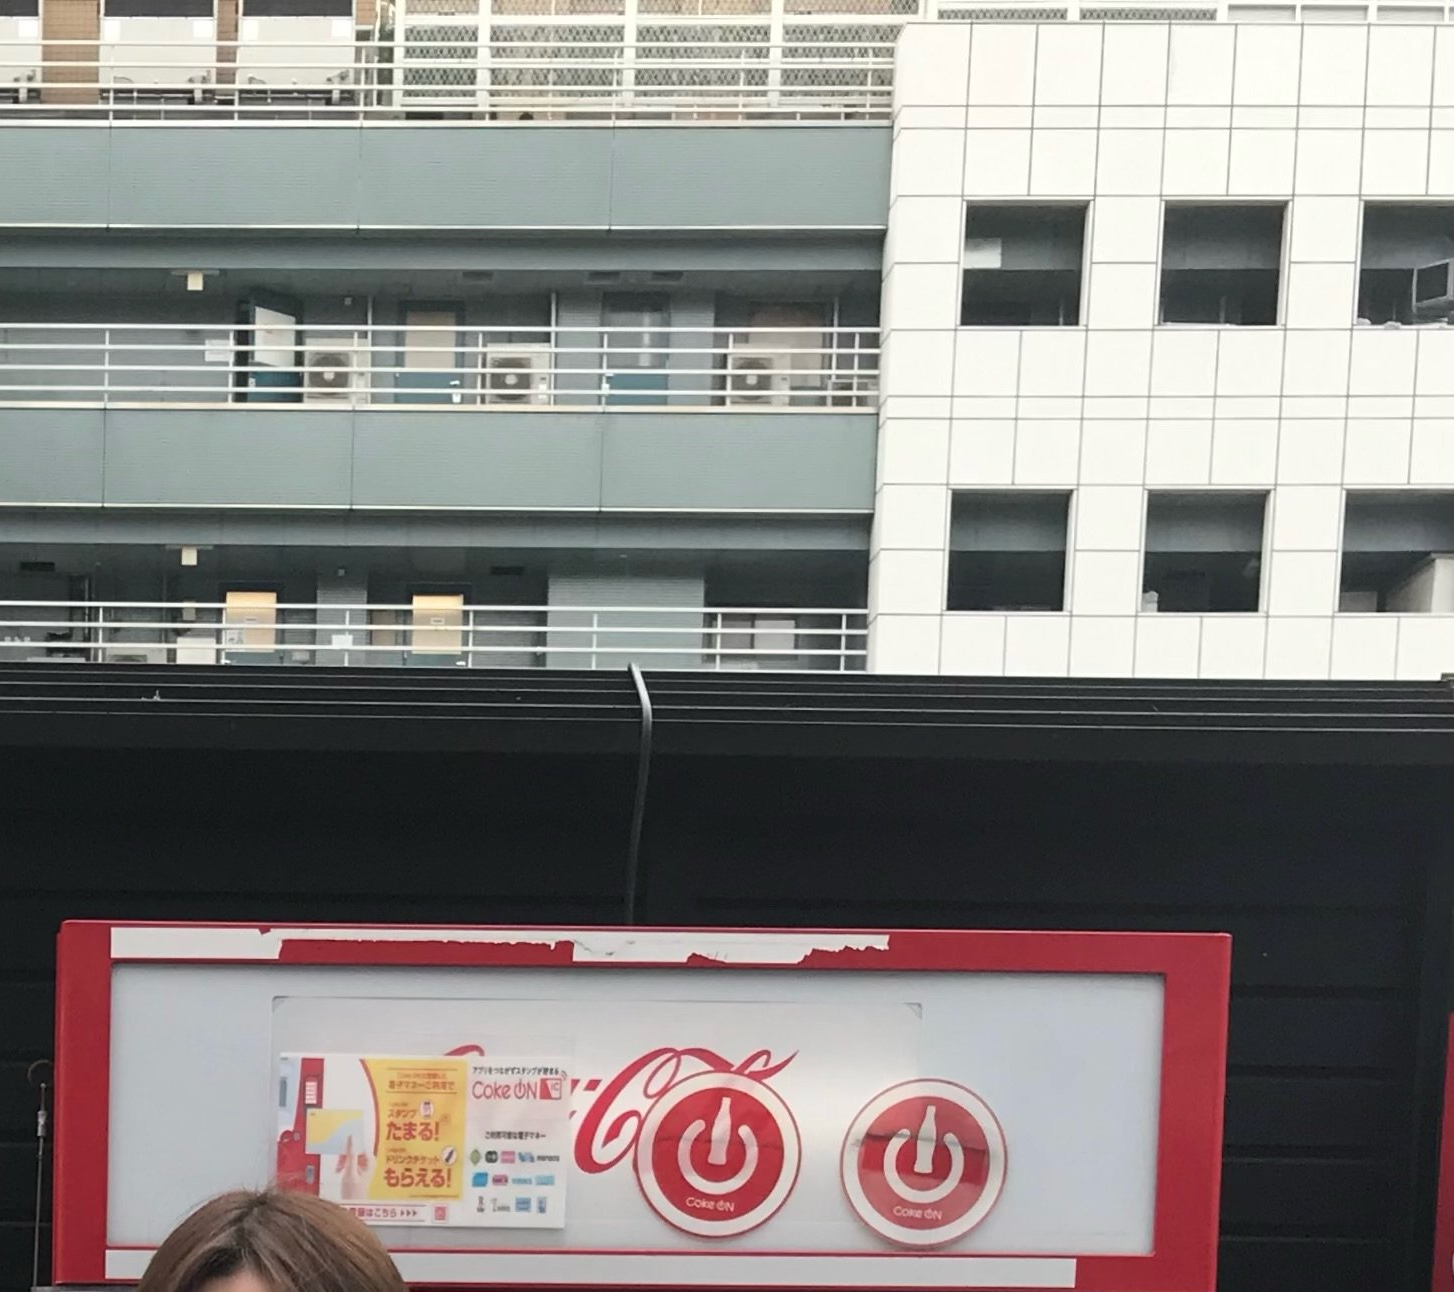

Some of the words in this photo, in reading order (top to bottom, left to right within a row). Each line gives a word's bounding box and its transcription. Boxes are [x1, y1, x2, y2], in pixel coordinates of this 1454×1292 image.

[471, 1080, 511, 1100] Coke
[513, 1078, 538, 1100] ON
[387, 1108, 417, 1119] スタンプ
[685, 1196, 715, 1210] Coke
[893, 1205, 922, 1219] Coke
